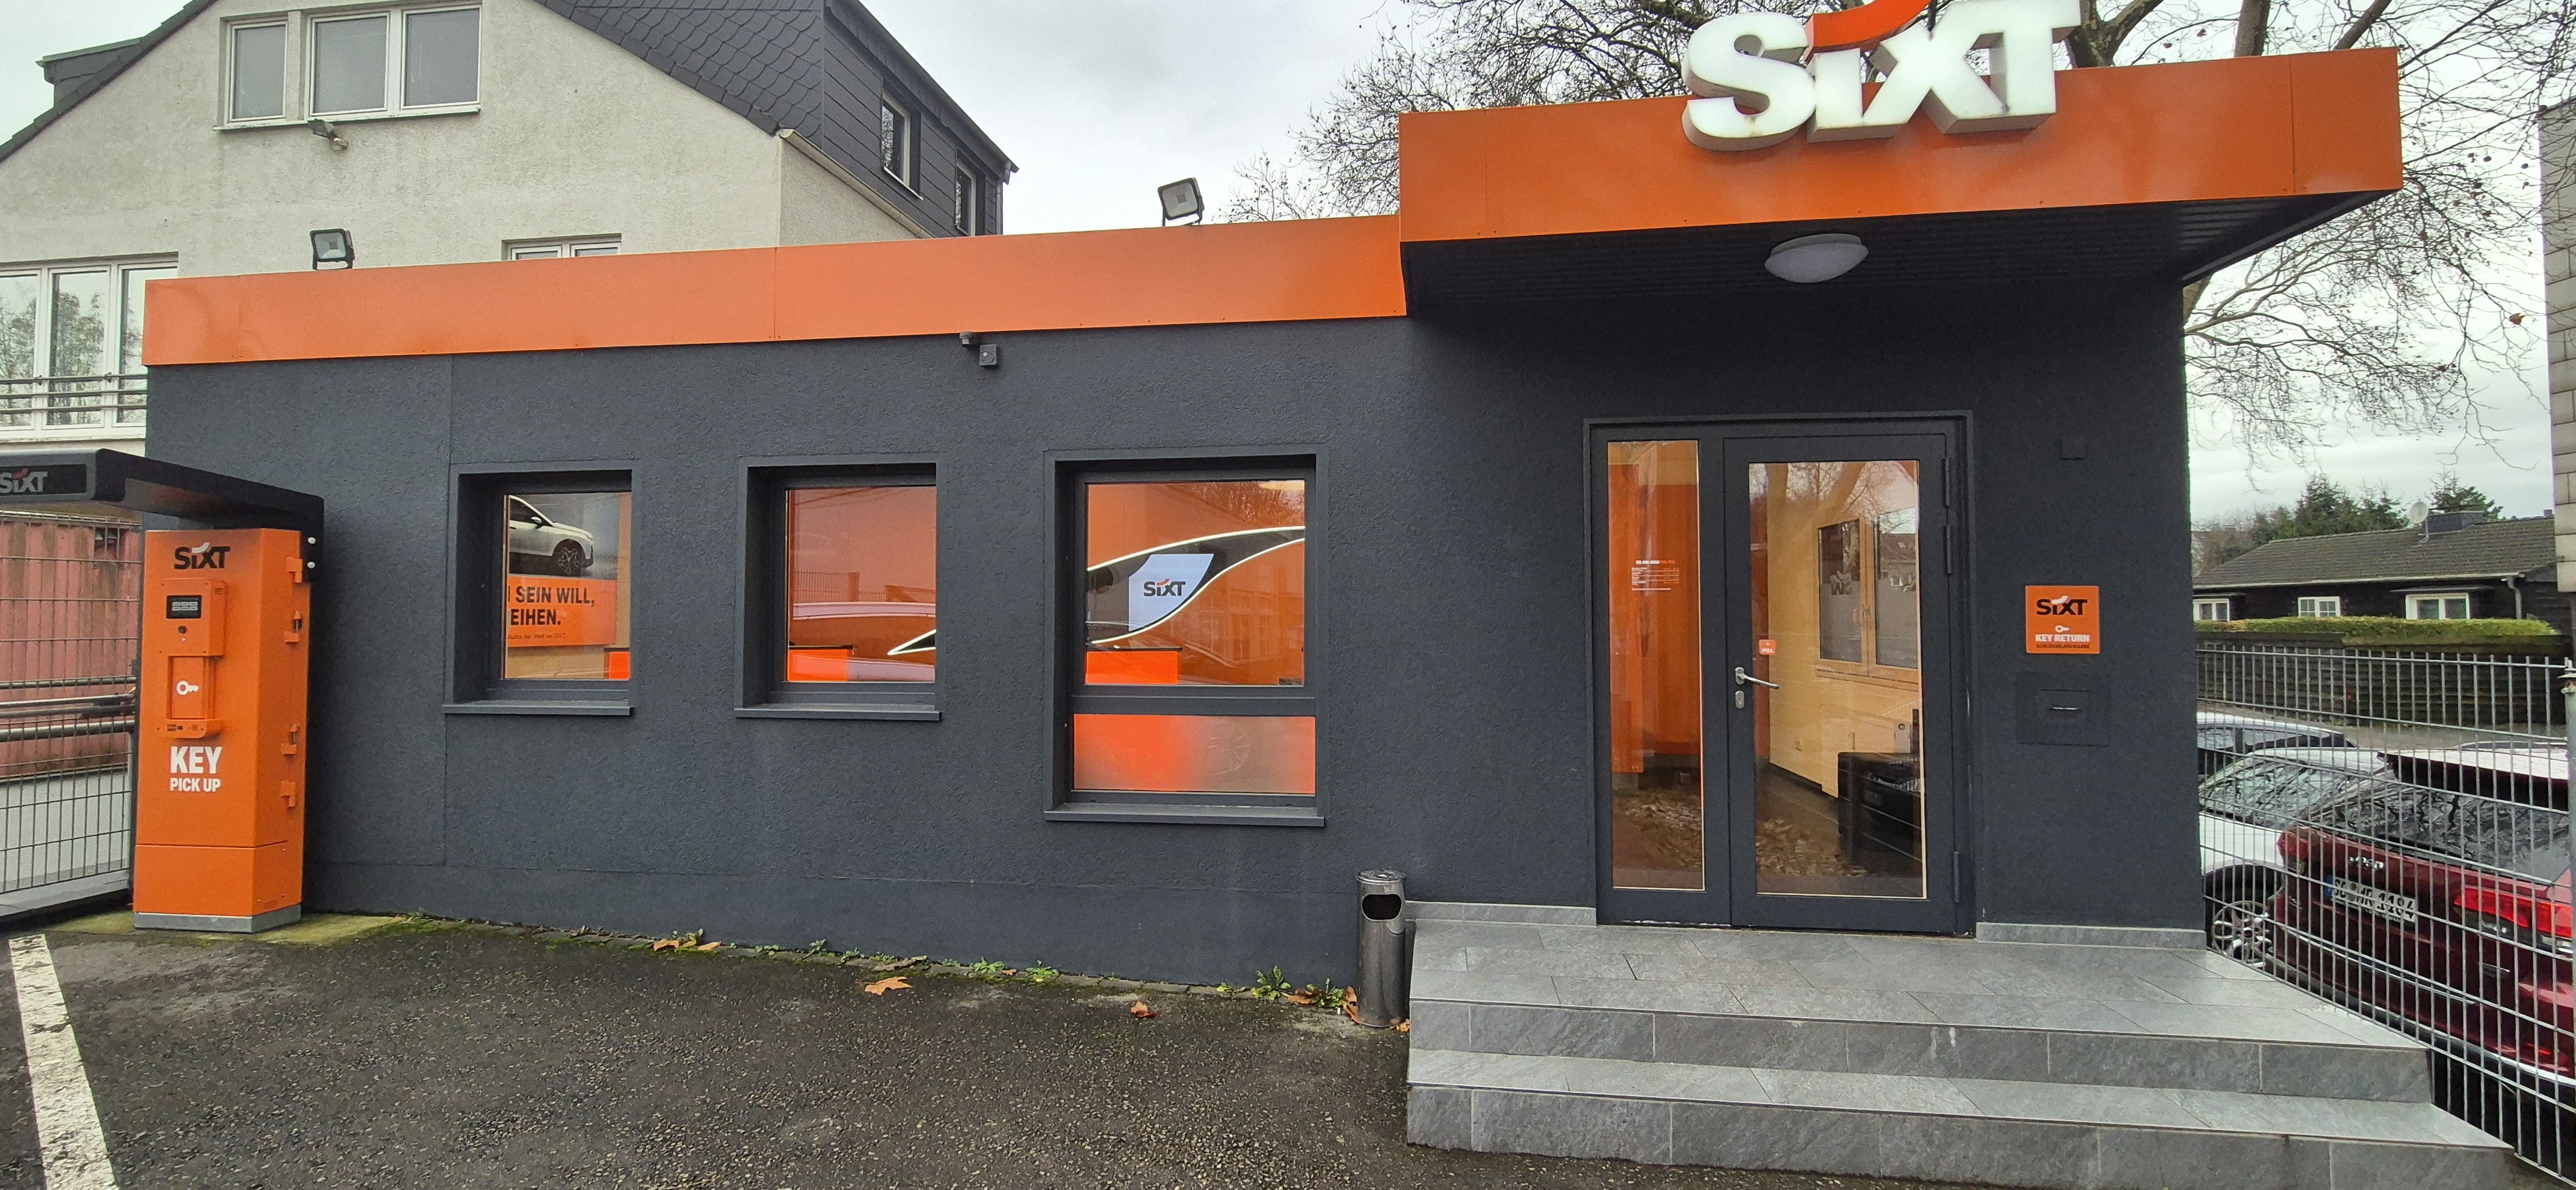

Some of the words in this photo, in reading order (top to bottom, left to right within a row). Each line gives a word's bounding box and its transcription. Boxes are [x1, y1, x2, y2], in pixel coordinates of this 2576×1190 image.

[515, 585, 552, 603] SEIN
[556, 587, 595, 607] WILL,
[2035, 634, 2053, 642] KEY
[2054, 634, 2090, 643] RETURN
[171, 746, 223, 774] KEY
[169, 777, 201, 792] PICK
[203, 778, 221, 792] UP
